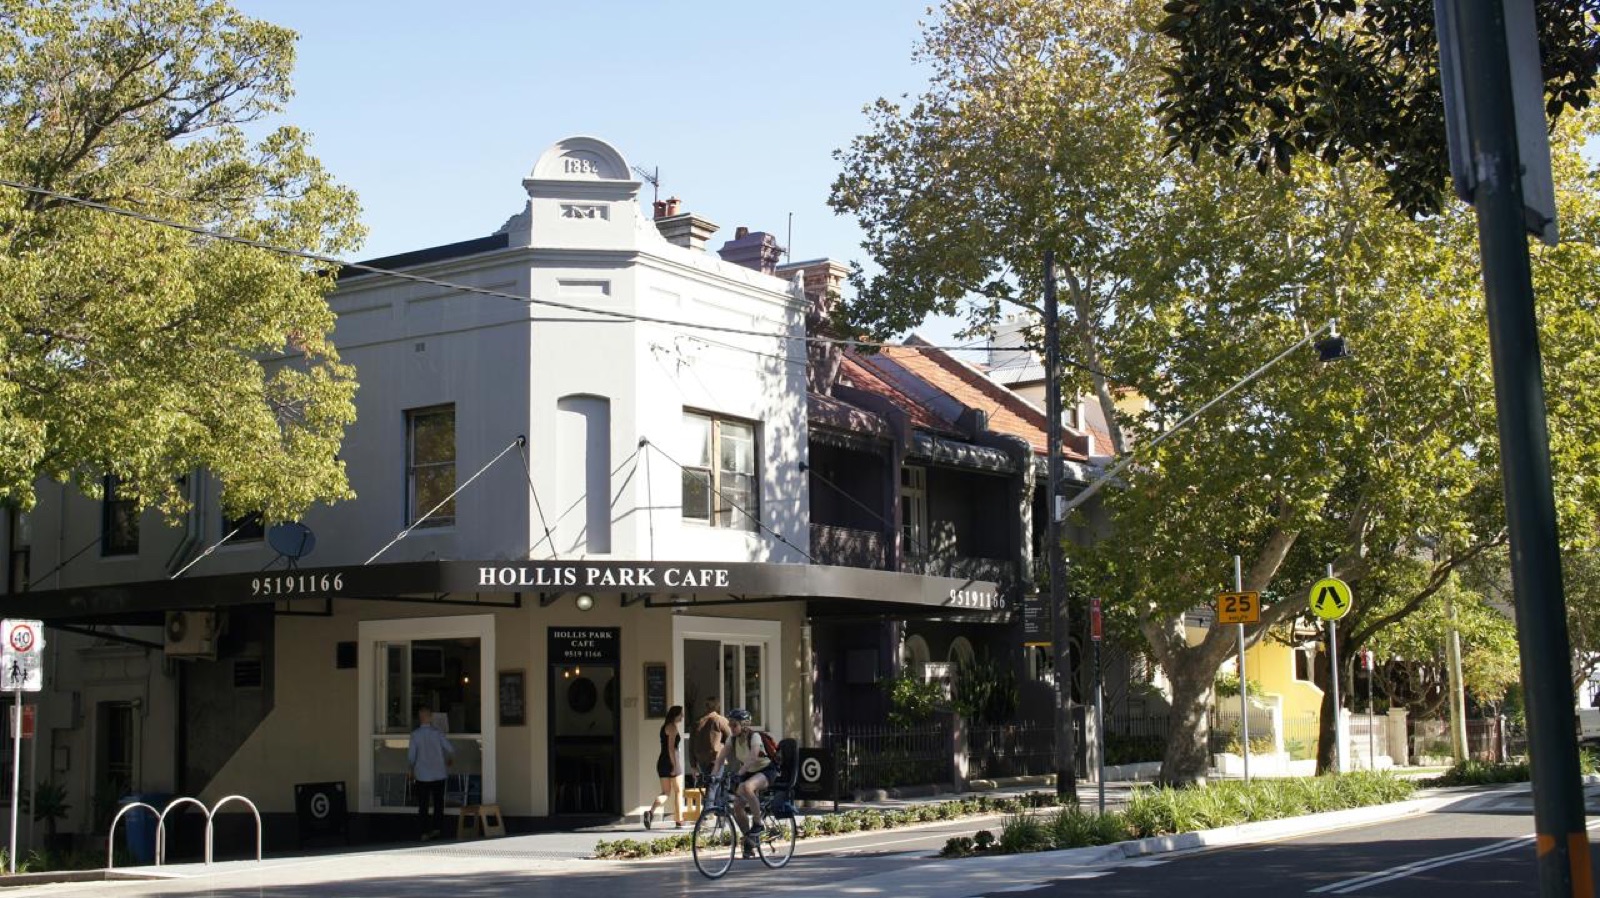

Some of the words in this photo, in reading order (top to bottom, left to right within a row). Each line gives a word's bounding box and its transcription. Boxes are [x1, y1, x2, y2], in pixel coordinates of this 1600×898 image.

[251, 573, 343, 596] 95191166
[478, 567, 577, 586] HOLLIS
[585, 567, 656, 586] PARK
[663, 568, 730, 587] CAFE
[949, 589, 1006, 609] 95191166
[1225, 596, 1251, 613] 25
[14, 631, 30, 644] 40
[554, 631, 587, 639] HOLLIS
[589, 631, 613, 639] PARK
[564, 650, 582, 658] 9519
[584, 650, 602, 658] 1166
